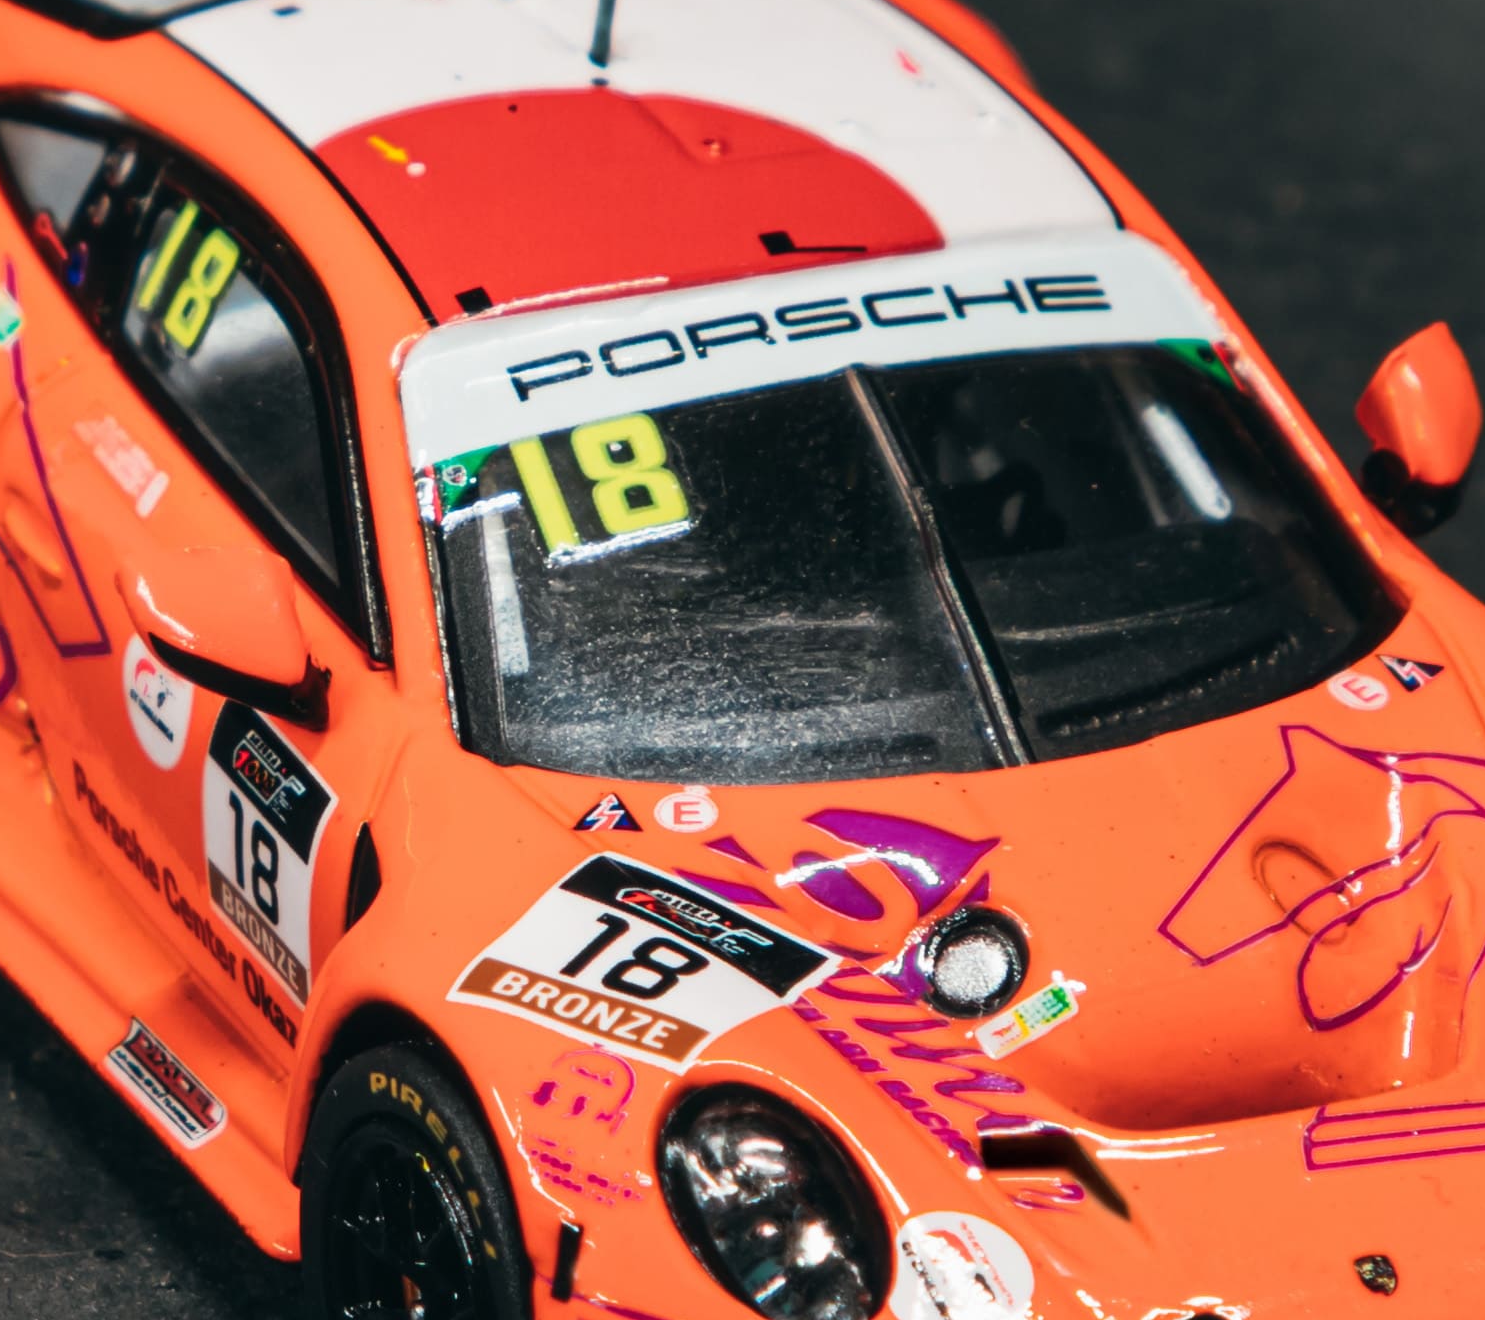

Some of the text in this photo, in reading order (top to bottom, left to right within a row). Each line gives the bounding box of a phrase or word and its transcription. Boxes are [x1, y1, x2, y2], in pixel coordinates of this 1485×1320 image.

[139, 199, 239, 349] 18
[507, 275, 1112, 401] PORSCHE
[509, 412, 690, 553] 18
[73, 758, 160, 893] Porsche
[163, 866, 236, 981] Center
[229, 789, 279, 926] 18
[673, 800, 703, 825] E
[222, 881, 299, 990] BRONZE
[559, 912, 710, 1000] 18
[491, 970, 679, 1050] BRONZE
[369, 1072, 497, 1260] PIRELLI
